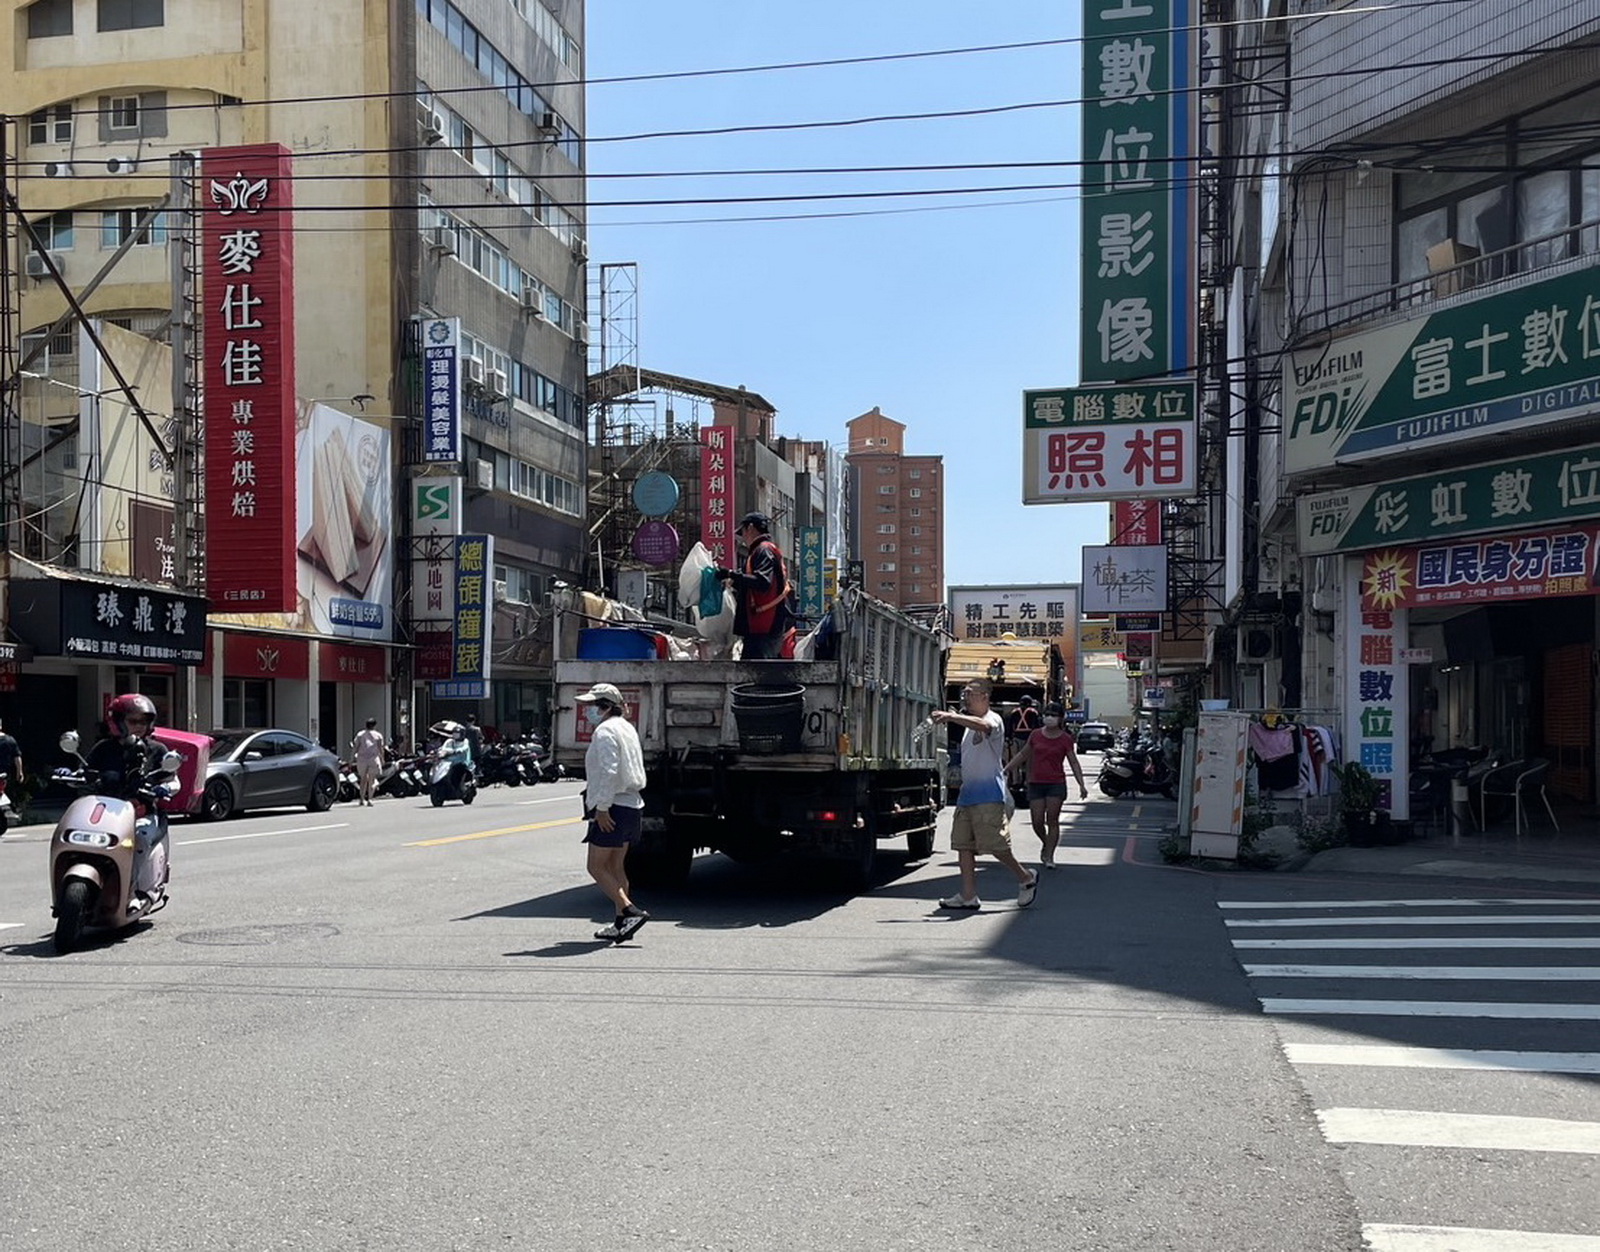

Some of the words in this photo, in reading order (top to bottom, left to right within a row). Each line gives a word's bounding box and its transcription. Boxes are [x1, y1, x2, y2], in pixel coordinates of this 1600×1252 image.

[219, 230, 263, 386] 麥仕佳
[430, 359, 451, 451] 理燙髮美容業
[1033, 390, 1187, 423] 電腦數位
[1290, 387, 1352, 439] FDi
[1397, 406, 1489, 440] FUJIFILM
[231, 399, 257, 518] 專業烘焙
[1048, 428, 1184, 490] 照相
[1310, 495, 1349, 511] FUJIFILM
[1374, 457, 1600, 534] 彩虹數位
[1376, 566, 1397, 594] 新
[1416, 532, 1590, 589] 國民身分證
[1545, 577, 1588, 596] 拍照處
[457, 541, 483, 673] 總領鐘錶
[965, 602, 1064, 620] 精工先驅
[966, 621, 1065, 639] 耐震智慧建築
